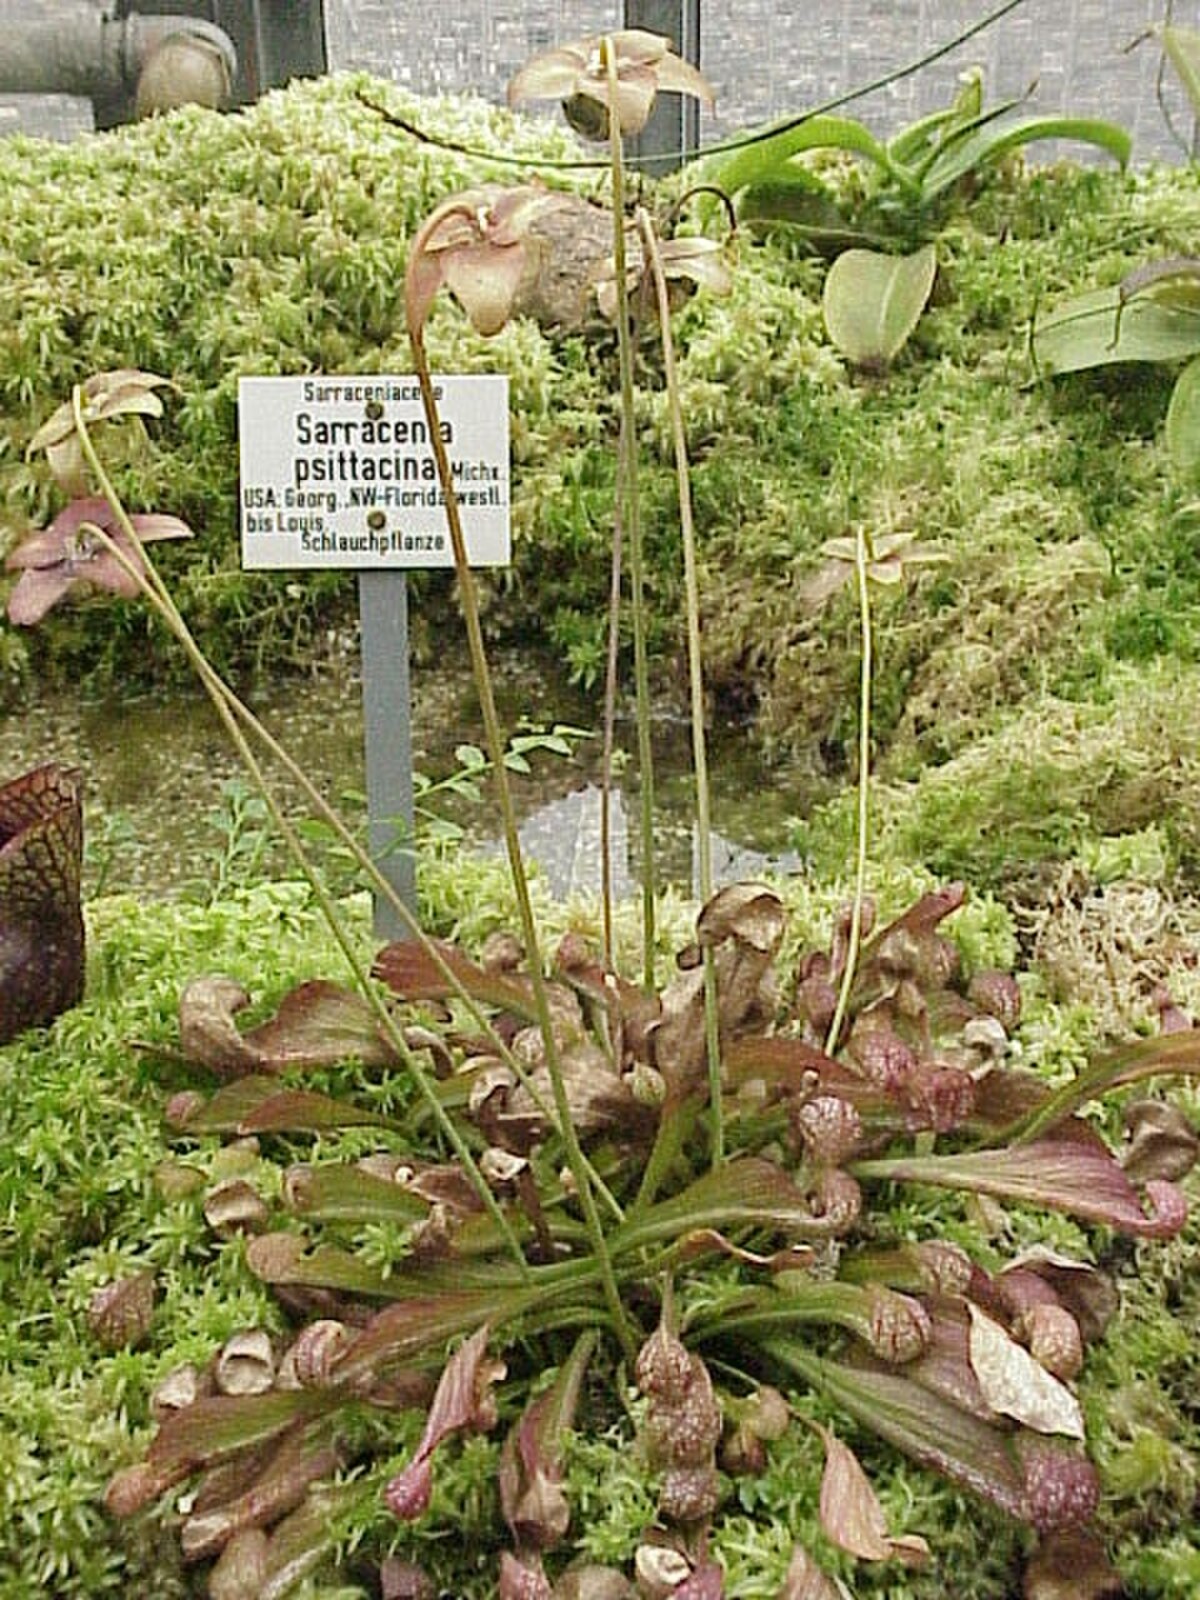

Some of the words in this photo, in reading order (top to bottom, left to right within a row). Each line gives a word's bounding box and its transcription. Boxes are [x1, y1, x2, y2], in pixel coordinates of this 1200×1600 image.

[303, 383, 443, 401] Sarraceniacee
[296, 414, 453, 444] Sarracena
[294, 451, 436, 489] psittacina
[246, 512, 273, 532] bis
[301, 530, 445, 556] Schlauchpflanze
